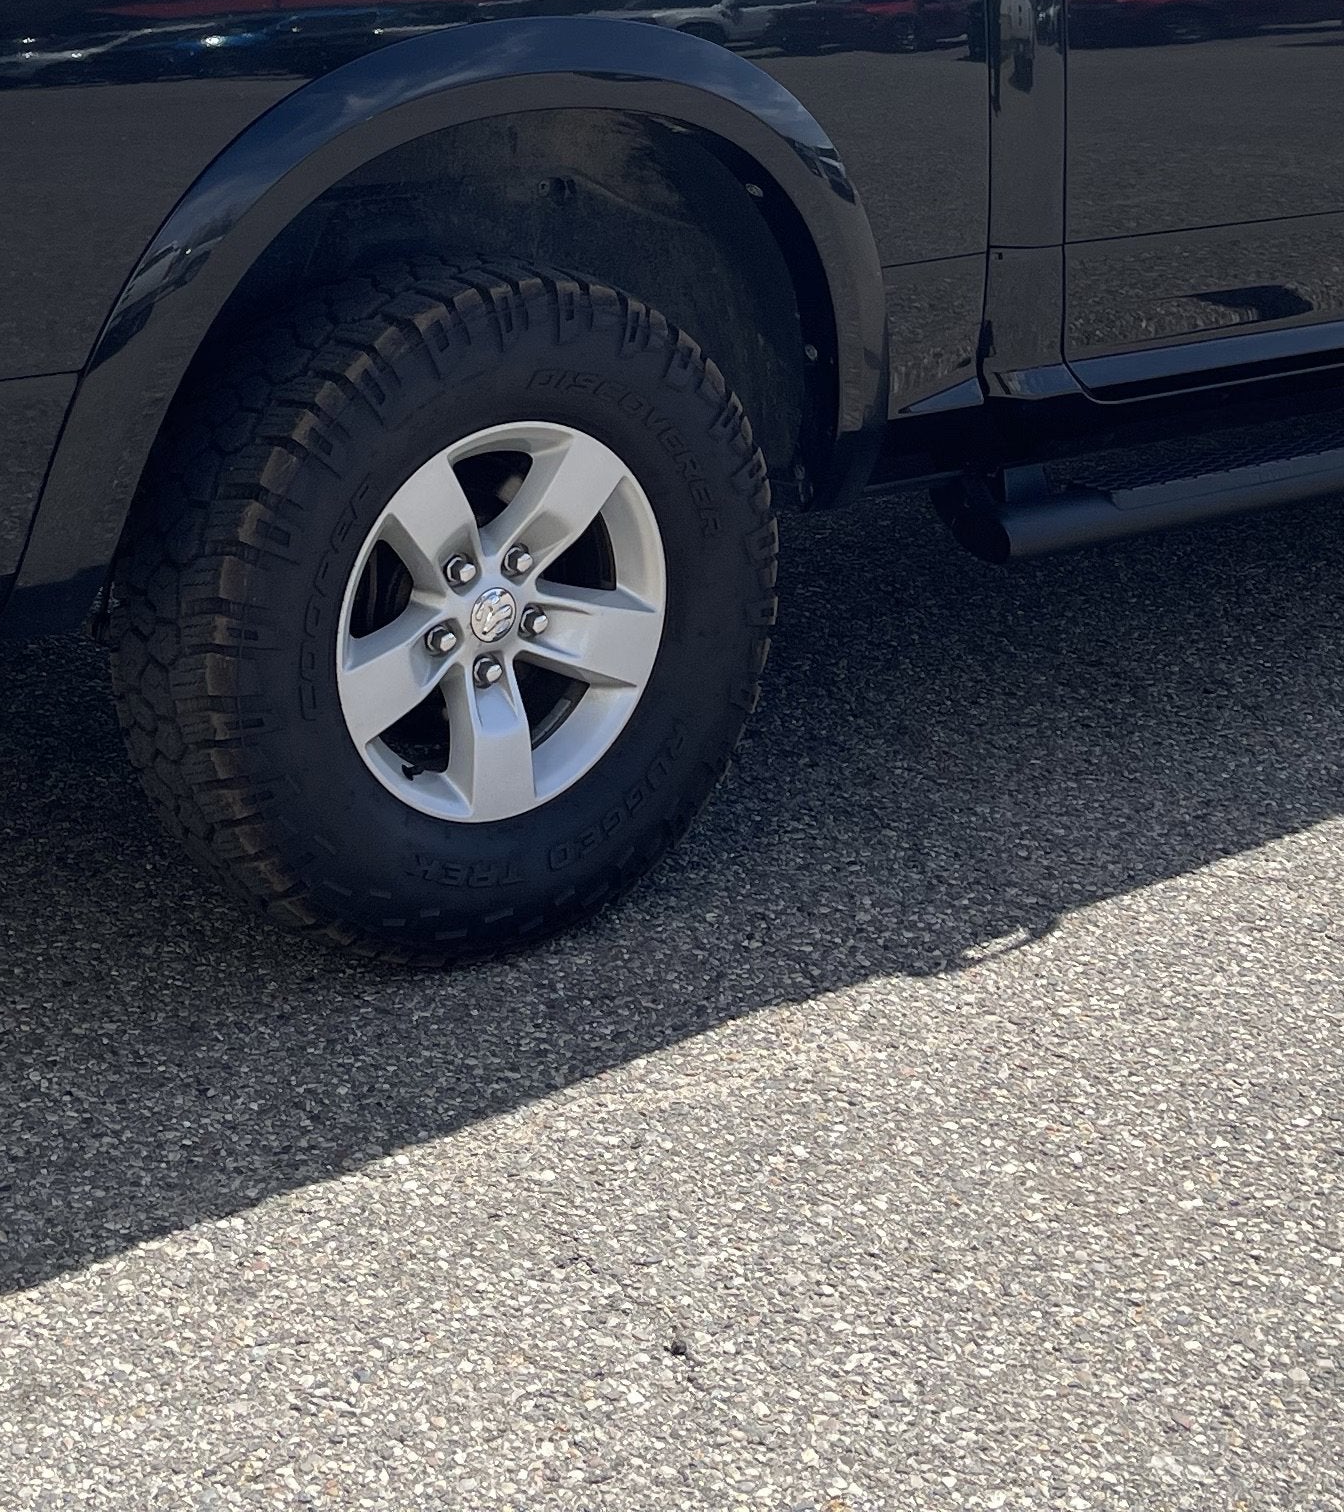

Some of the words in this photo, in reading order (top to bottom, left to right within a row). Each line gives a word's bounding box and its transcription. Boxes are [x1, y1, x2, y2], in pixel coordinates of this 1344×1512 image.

[527, 368, 722, 538] DISCOVERER
[299, 473, 372, 722] COOPER
[409, 852, 526, 888] TREK
[547, 736, 686, 872] RUGGED
